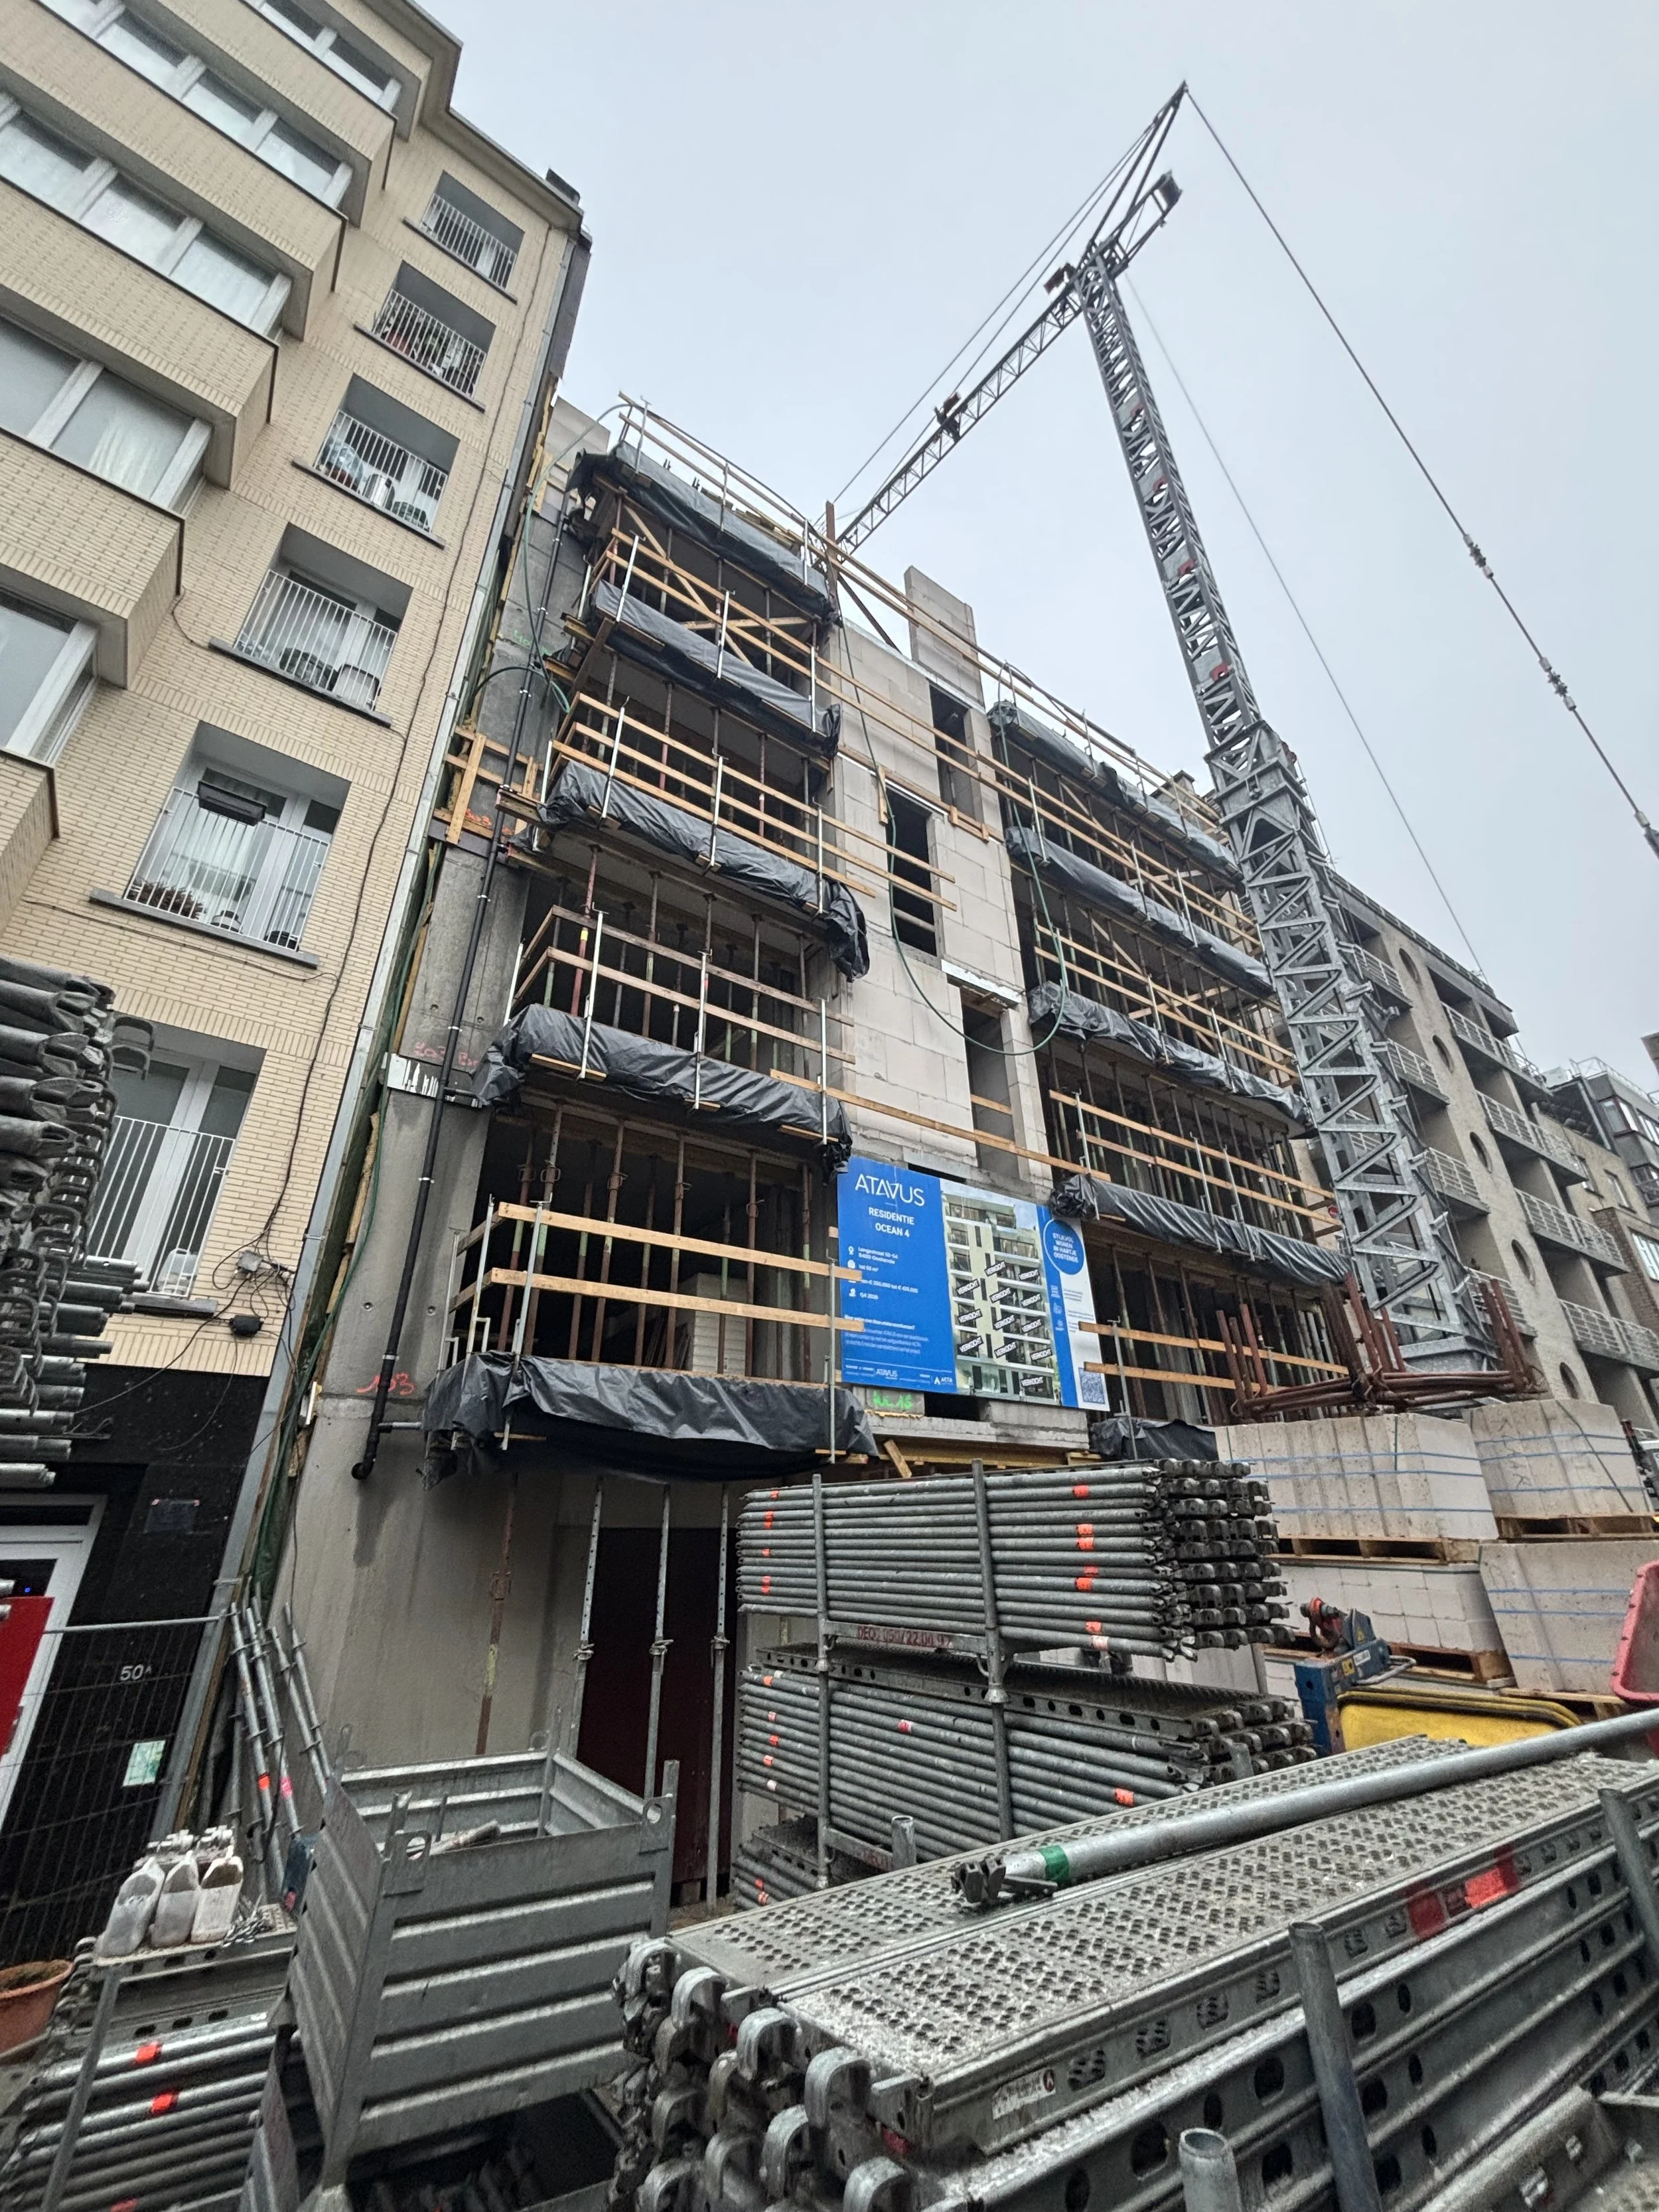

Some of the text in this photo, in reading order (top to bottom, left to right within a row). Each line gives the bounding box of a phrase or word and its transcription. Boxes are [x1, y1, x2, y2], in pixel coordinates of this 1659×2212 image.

[855, 1173, 925, 1207] ATAVUS
[868, 1207, 914, 1225] RESIDENTIE
[875, 1222, 910, 1238] OCEAN 4
[985, 1261, 1006, 1276] VERKOCHT
[1019, 1269, 1039, 1280] VERKOCHT
[957, 1280, 979, 1295] VERKOCHT
[990, 1287, 1011, 1303] VERKOCHT
[1021, 1294, 1041, 1307] VERKOCHT
[958, 1309, 981, 1323] VERKOCHT
[994, 1314, 1015, 1330] VERKOCHT
[1021, 1319, 1042, 1333] VERKOCHT
[959, 1337, 982, 1353] VERKOCHT
[995, 1342, 1017, 1357] VERKOCHT
[1031, 1349, 1051, 1361] VERKOCHT
[875, 1368, 898, 1378] ATAVUS
[1021, 1376, 1044, 1387] VERKOCHT
